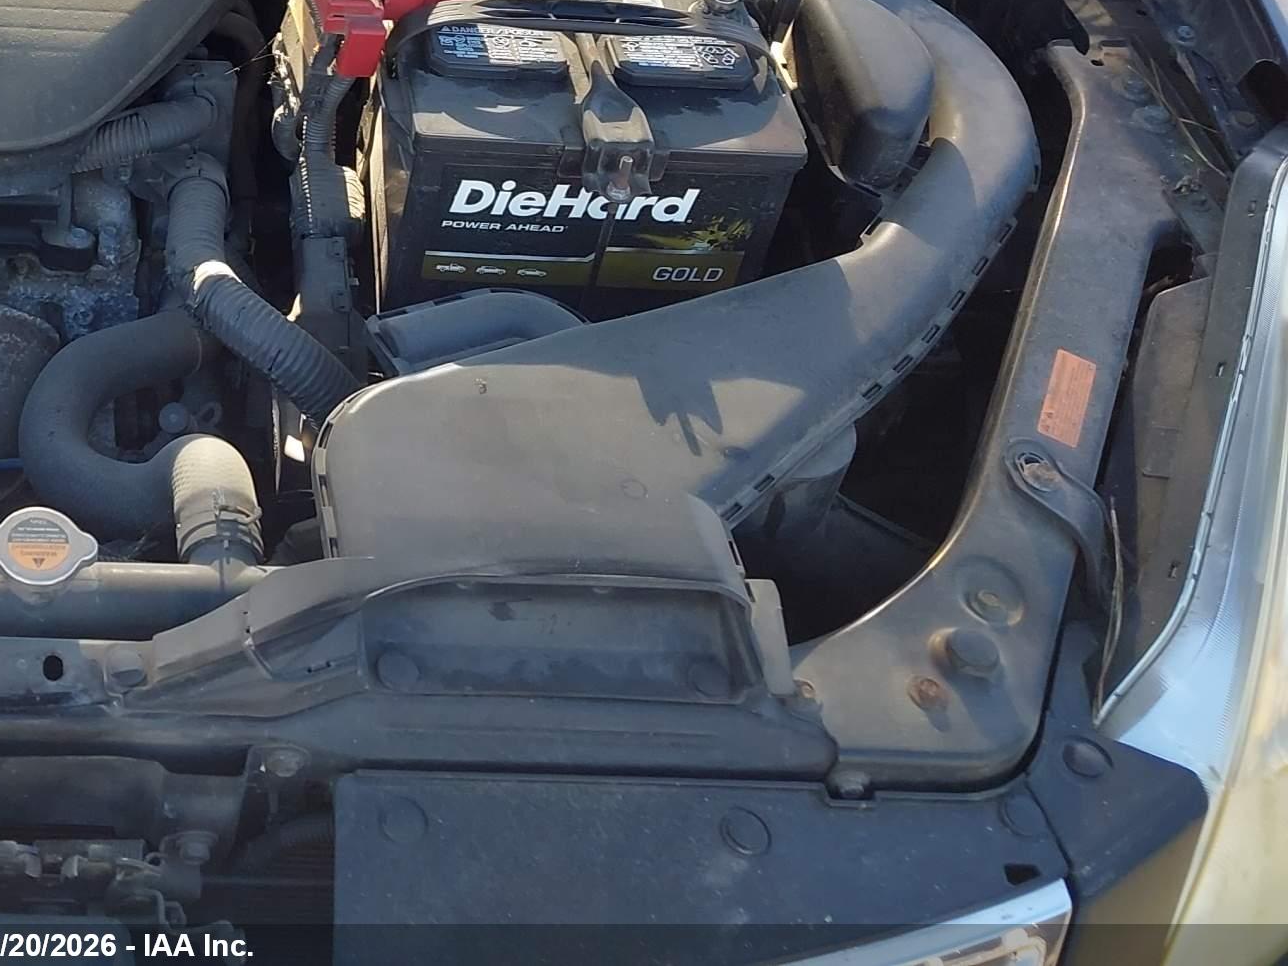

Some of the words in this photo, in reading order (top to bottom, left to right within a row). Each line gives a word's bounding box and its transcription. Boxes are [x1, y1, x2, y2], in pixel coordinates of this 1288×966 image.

[441, 219, 501, 231] POWER
[505, 223, 565, 233] AHEAD
[652, 266, 724, 283] GOLD
